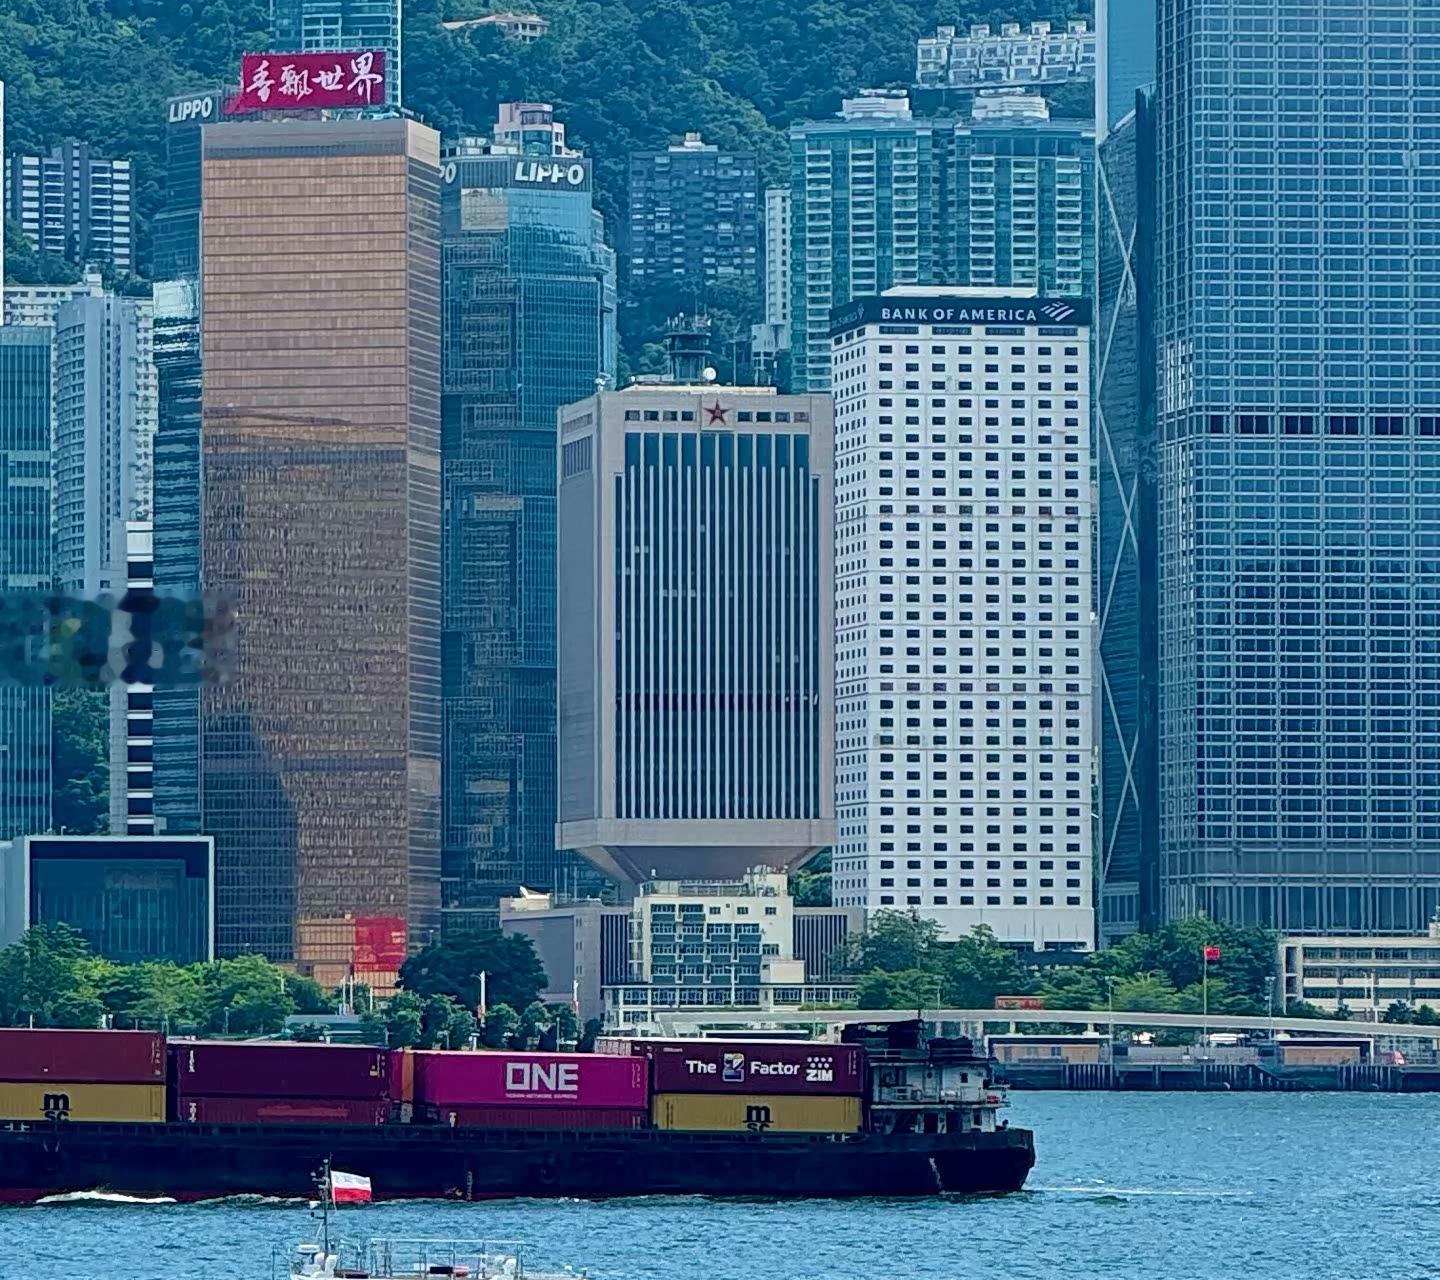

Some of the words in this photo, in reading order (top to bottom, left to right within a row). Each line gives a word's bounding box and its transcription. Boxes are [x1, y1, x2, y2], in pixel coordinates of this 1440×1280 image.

[168, 96, 213, 123] LIPPO
[514, 161, 584, 186] LIPPO
[881, 307, 928, 320] BANK
[932, 308, 955, 321] OF
[959, 308, 1037, 322] AMERICA
[506, 1062, 579, 1091] ONE
[686, 1060, 717, 1074] The
[750, 1061, 800, 1076] Factor
[806, 1069, 833, 1082] ZIM
